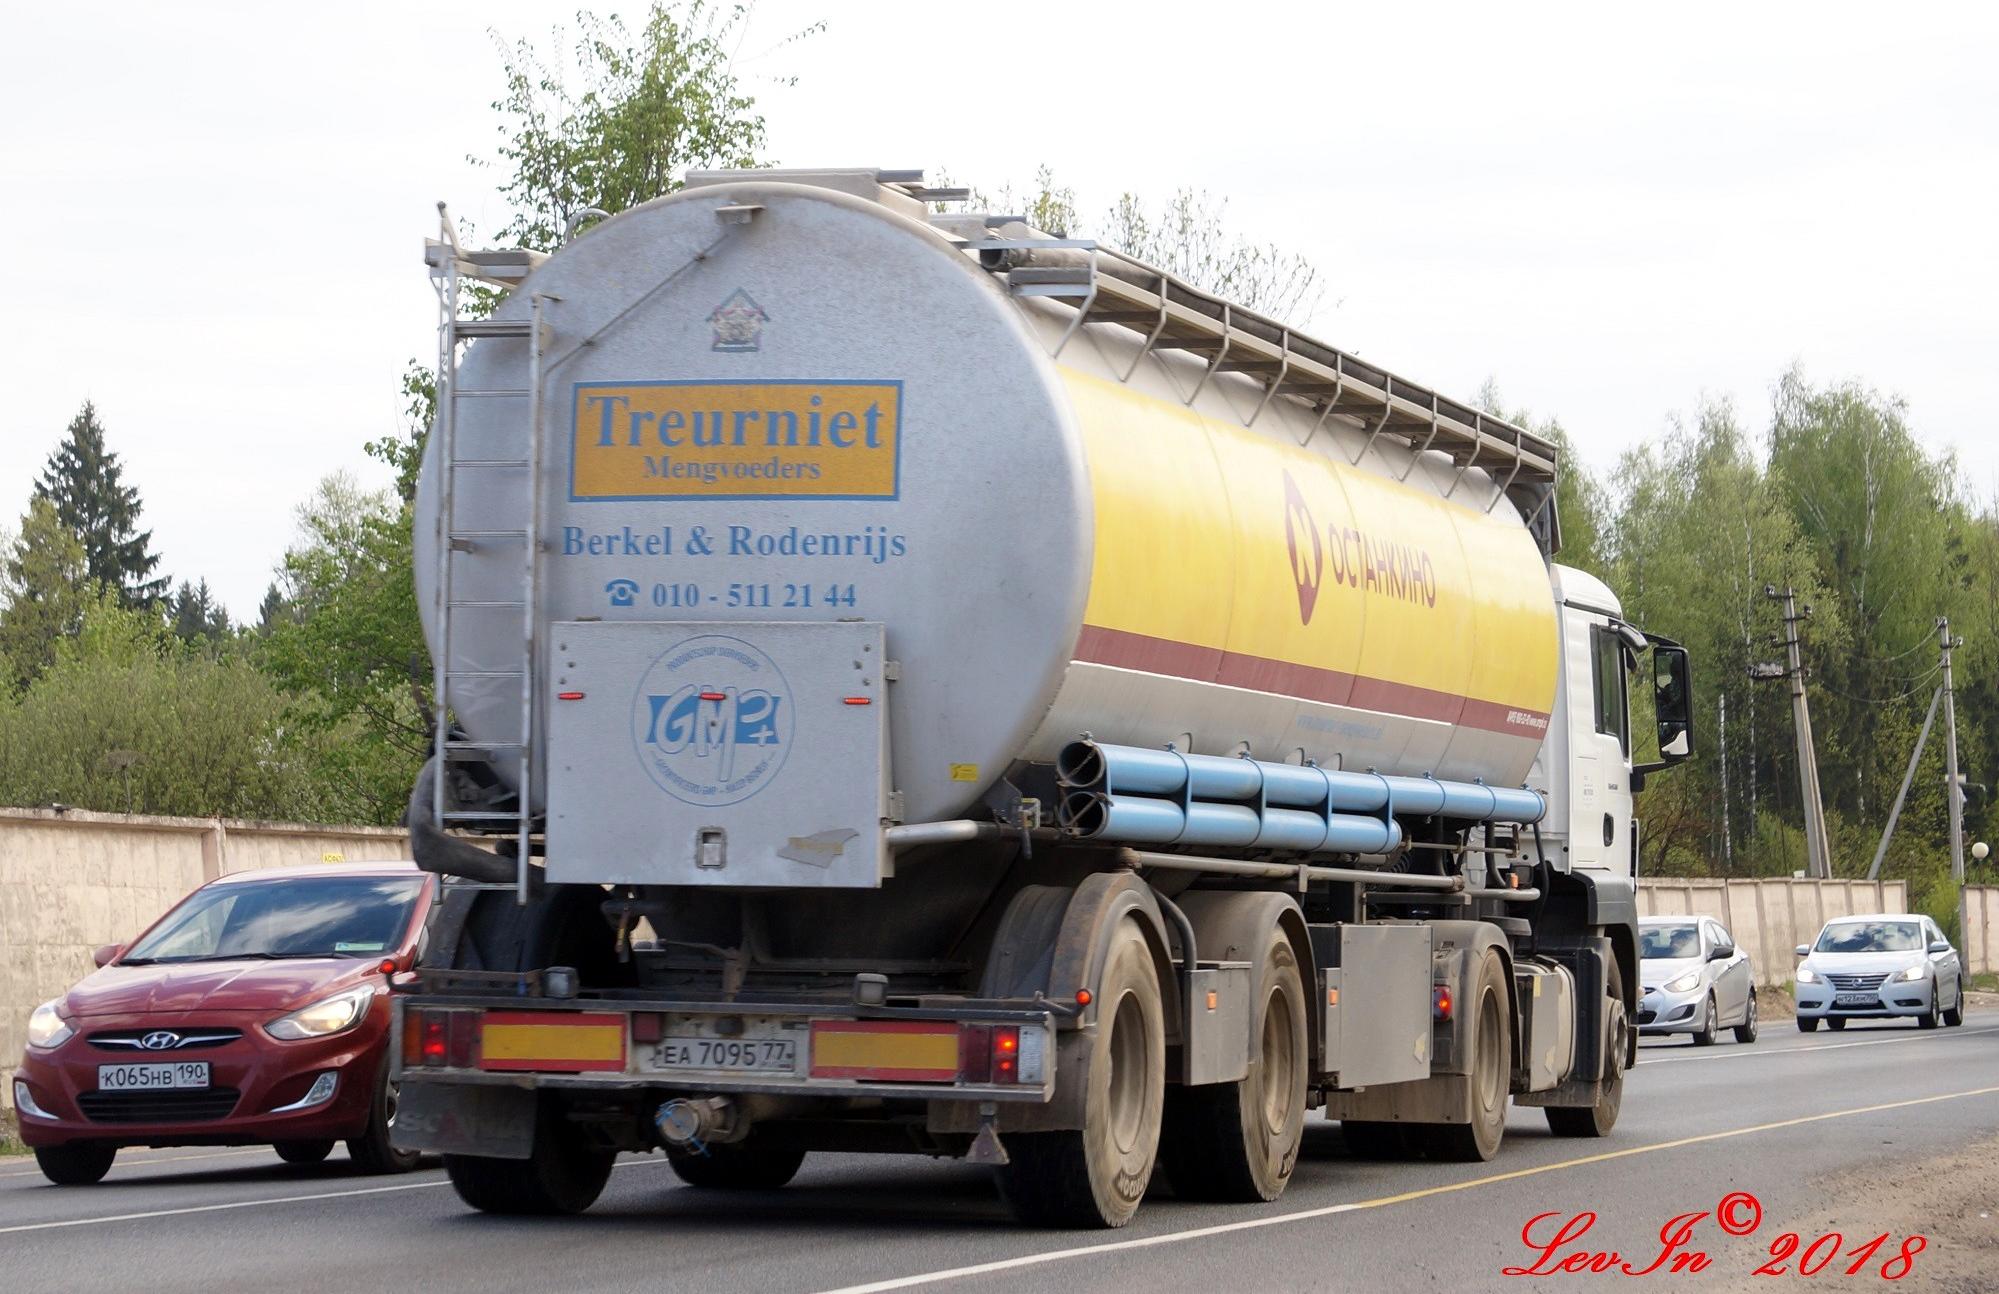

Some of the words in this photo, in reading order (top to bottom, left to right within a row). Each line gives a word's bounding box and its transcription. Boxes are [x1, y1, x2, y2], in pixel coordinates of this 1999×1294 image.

[587, 394, 885, 449] Treurniet
[642, 455, 822, 483] Mengvoeders
[562, 525, 672, 556] Berkel
[685, 525, 714, 557] &
[728, 525, 907, 564] Rodenrijs
[1328, 522, 1436, 609] ОСТАНКИНО
[652, 583, 700, 608] 010
[726, 583, 772, 608] 511
[782, 583, 813, 608] 21
[824, 583, 857, 608] 44
[698, 1041, 757, 1067] 7095
[177, 1064, 203, 1080] 190
